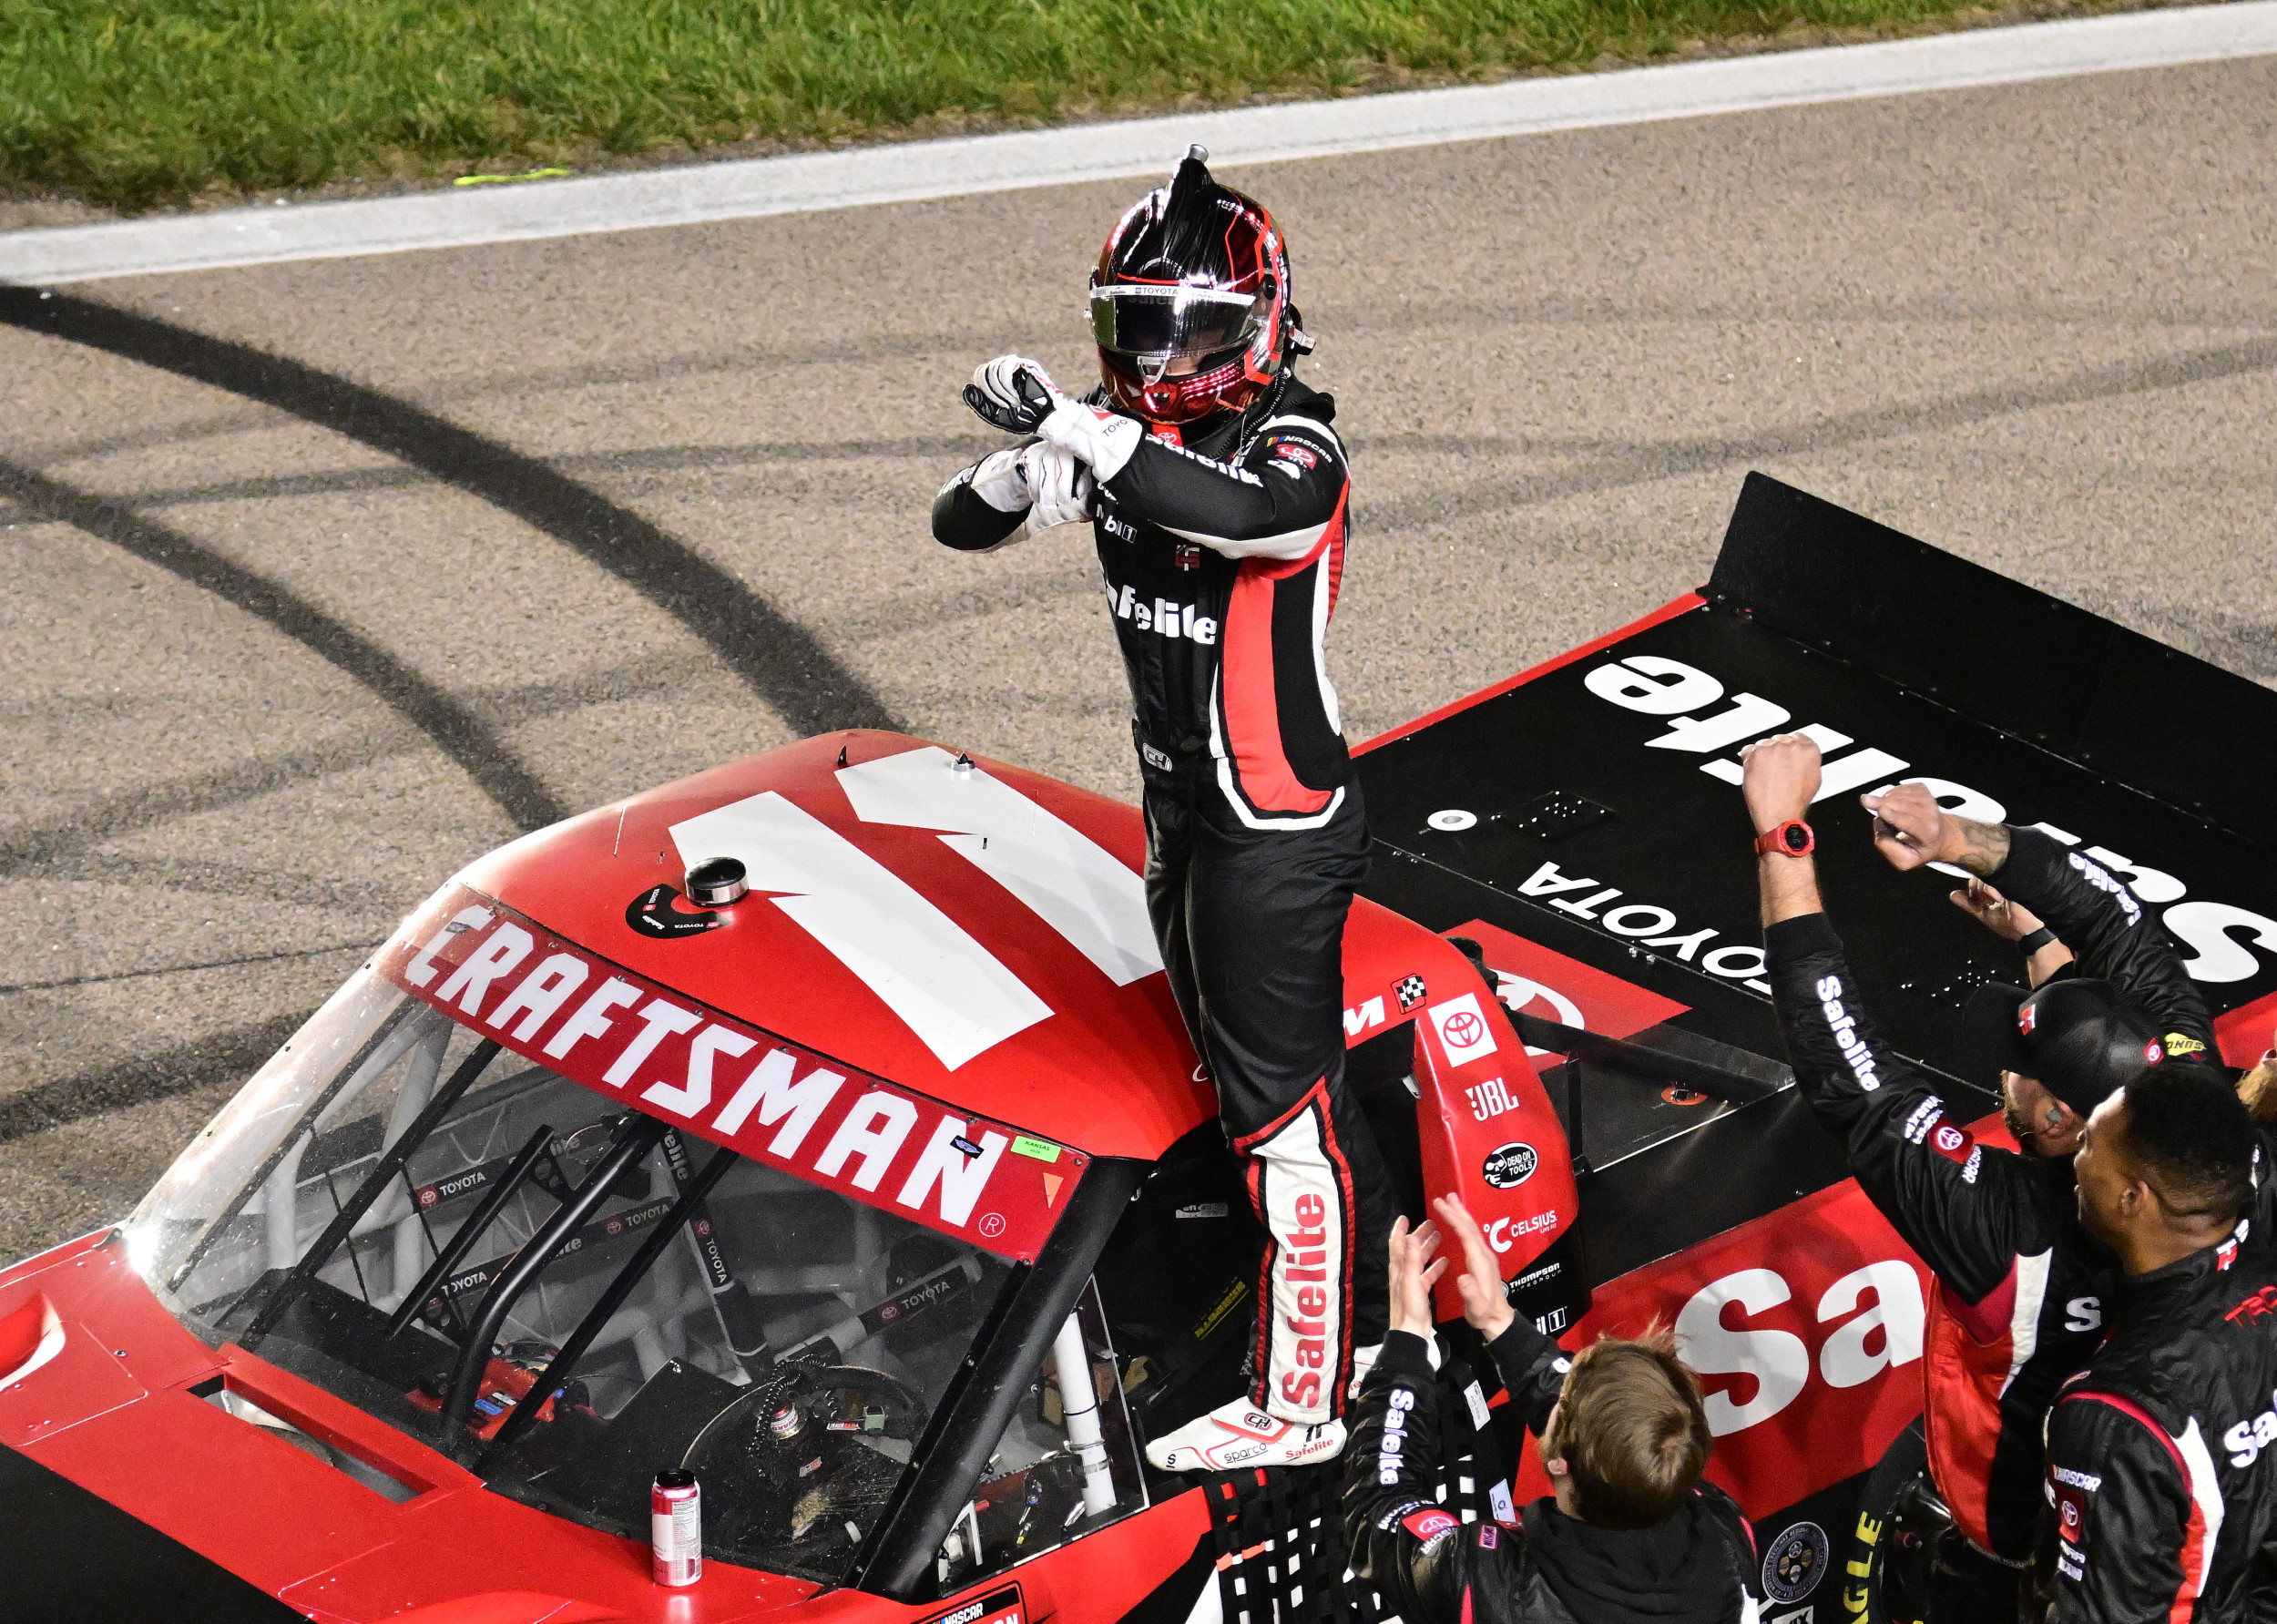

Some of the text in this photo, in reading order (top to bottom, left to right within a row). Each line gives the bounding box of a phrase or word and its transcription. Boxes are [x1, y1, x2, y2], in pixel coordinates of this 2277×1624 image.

[1142, 287, 1179, 296] TOYOTA
[1102, 419, 1135, 437] TOYO
[1284, 434, 1333, 464] NASCAR
[1096, 503, 1122, 537] Mbil
[1105, 578, 1218, 645] felite
[1584, 655, 2277, 983] Saelite
[668, 746, 1166, 1073] 11
[1517, 861, 1772, 996] OYOTA
[1816, 975, 1881, 1093] Safelite
[2167, 1039, 2203, 1051] SUNO
[406, 904, 1009, 1228] CRAFTSMAN
[1473, 1077, 1520, 1121] JBL
[1025, 1140, 1050, 1151] KANSAS
[1507, 1150, 1531, 1167] DEAD ON
[1508, 1161, 1533, 1176] TOOLS
[1962, 1145, 1982, 1184] SCAR
[439, 1171, 486, 1197] TOYOTA
[626, 1204, 670, 1227] TOYOTA
[1510, 1210, 1557, 1238] CELSIUS
[706, 1237, 728, 1283] TOYOTA
[1508, 1261, 1560, 1289] THOMPSON
[901, 1281, 951, 1310] TOYOTA
[1281, 1194, 1327, 1408] Safelite
[1285, 1437, 1334, 1459] Safelite
[1378, 1388, 1414, 1486] Safelite
[1223, 1442, 1268, 1464] sparco
[1420, 1525, 1458, 1555] SCAR
[944, 1602, 984, 1624] NASCAR
